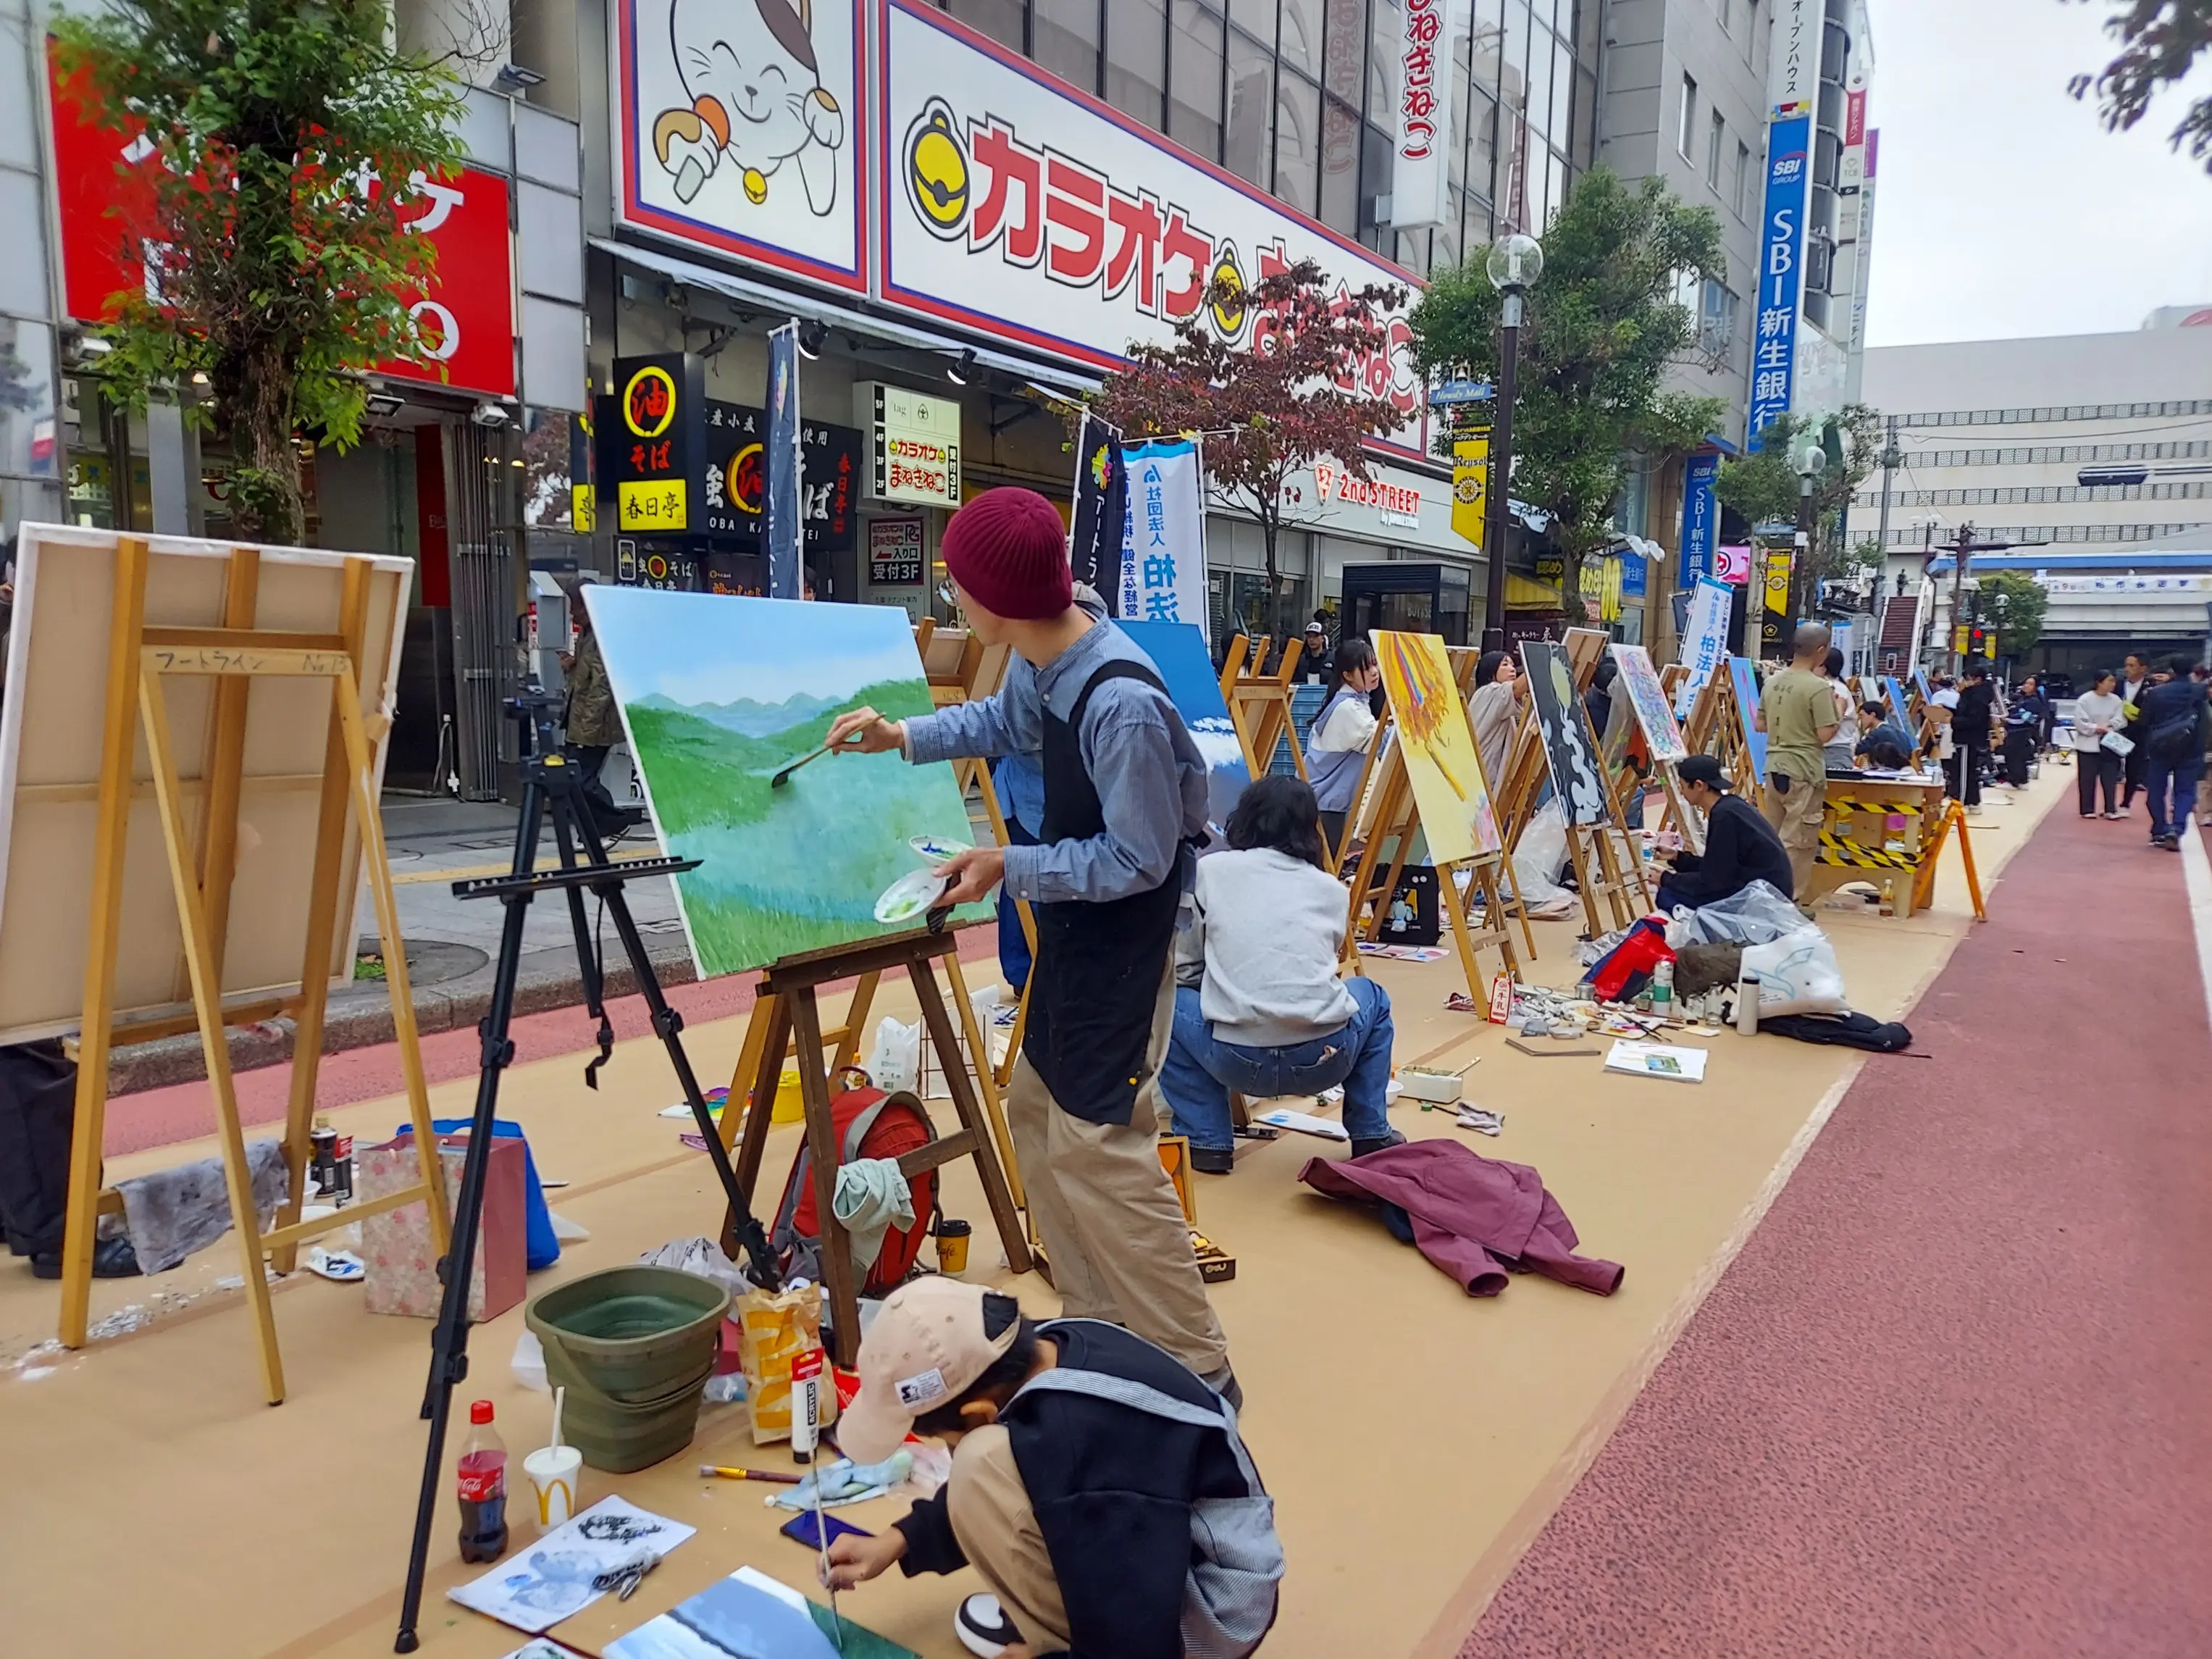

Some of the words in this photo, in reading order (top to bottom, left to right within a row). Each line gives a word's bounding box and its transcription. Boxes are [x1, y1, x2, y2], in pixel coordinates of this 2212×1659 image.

[1785, 0, 1803, 94] オープンハウス
[1773, 159, 1801, 175] SBI
[1772, 174, 1801, 185] GROUP
[971, 122, 1213, 319] カラオケ
[1252, 243, 1417, 413] まきねこ
[1465, 386, 1486, 397] Mall
[630, 377, 670, 426] 油
[876, 399, 884, 409] 5F
[704, 407, 755, 433] 産小麦
[803, 427, 828, 446] 使用
[876, 433, 884, 442] 4F
[630, 439, 672, 472] そば
[897, 440, 938, 461] カラオケ
[876, 456, 884, 466] 3F
[1453, 454, 1488, 469] Reysol
[876, 479, 885, 489] 2F
[889, 464, 945, 493] まねきねこ
[1339, 473, 1367, 503] 2nd
[1370, 481, 1420, 514] STREET
[626, 491, 679, 520] 春日亭
[709, 516, 735, 531] OBA
[893, 548, 918, 559] 入り口
[873, 563, 919, 580] 受付3F
